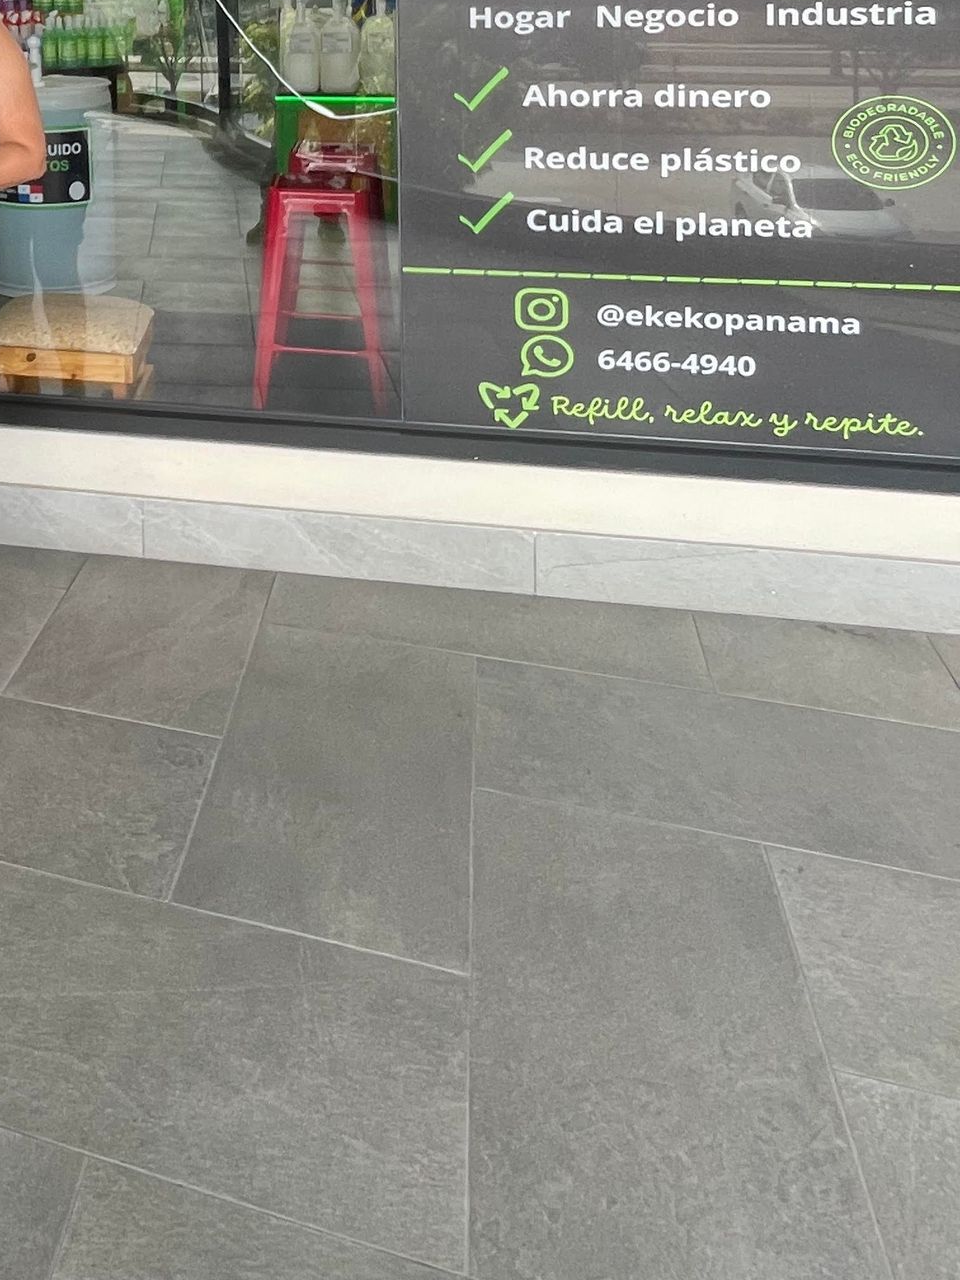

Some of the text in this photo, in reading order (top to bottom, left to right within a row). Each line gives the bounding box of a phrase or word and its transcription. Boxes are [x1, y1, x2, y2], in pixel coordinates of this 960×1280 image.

[469, 0, 937, 34] Hogar Negocio Industria
[522, 83, 771, 109] Ahorra dinero
[843, 103, 945, 140] BIODEGRADABLE
[45, 142, 82, 156] UIDO
[523, 146, 802, 178] Reduce plástico
[846, 153, 940, 181] ECO FRIENDLY
[526, 208, 814, 241] Cuida el planeta
[596, 303, 861, 336] @ekekopanama
[597, 350, 756, 377] 6466-4940
[551, 394, 924, 439] Refill, relax y repite.
